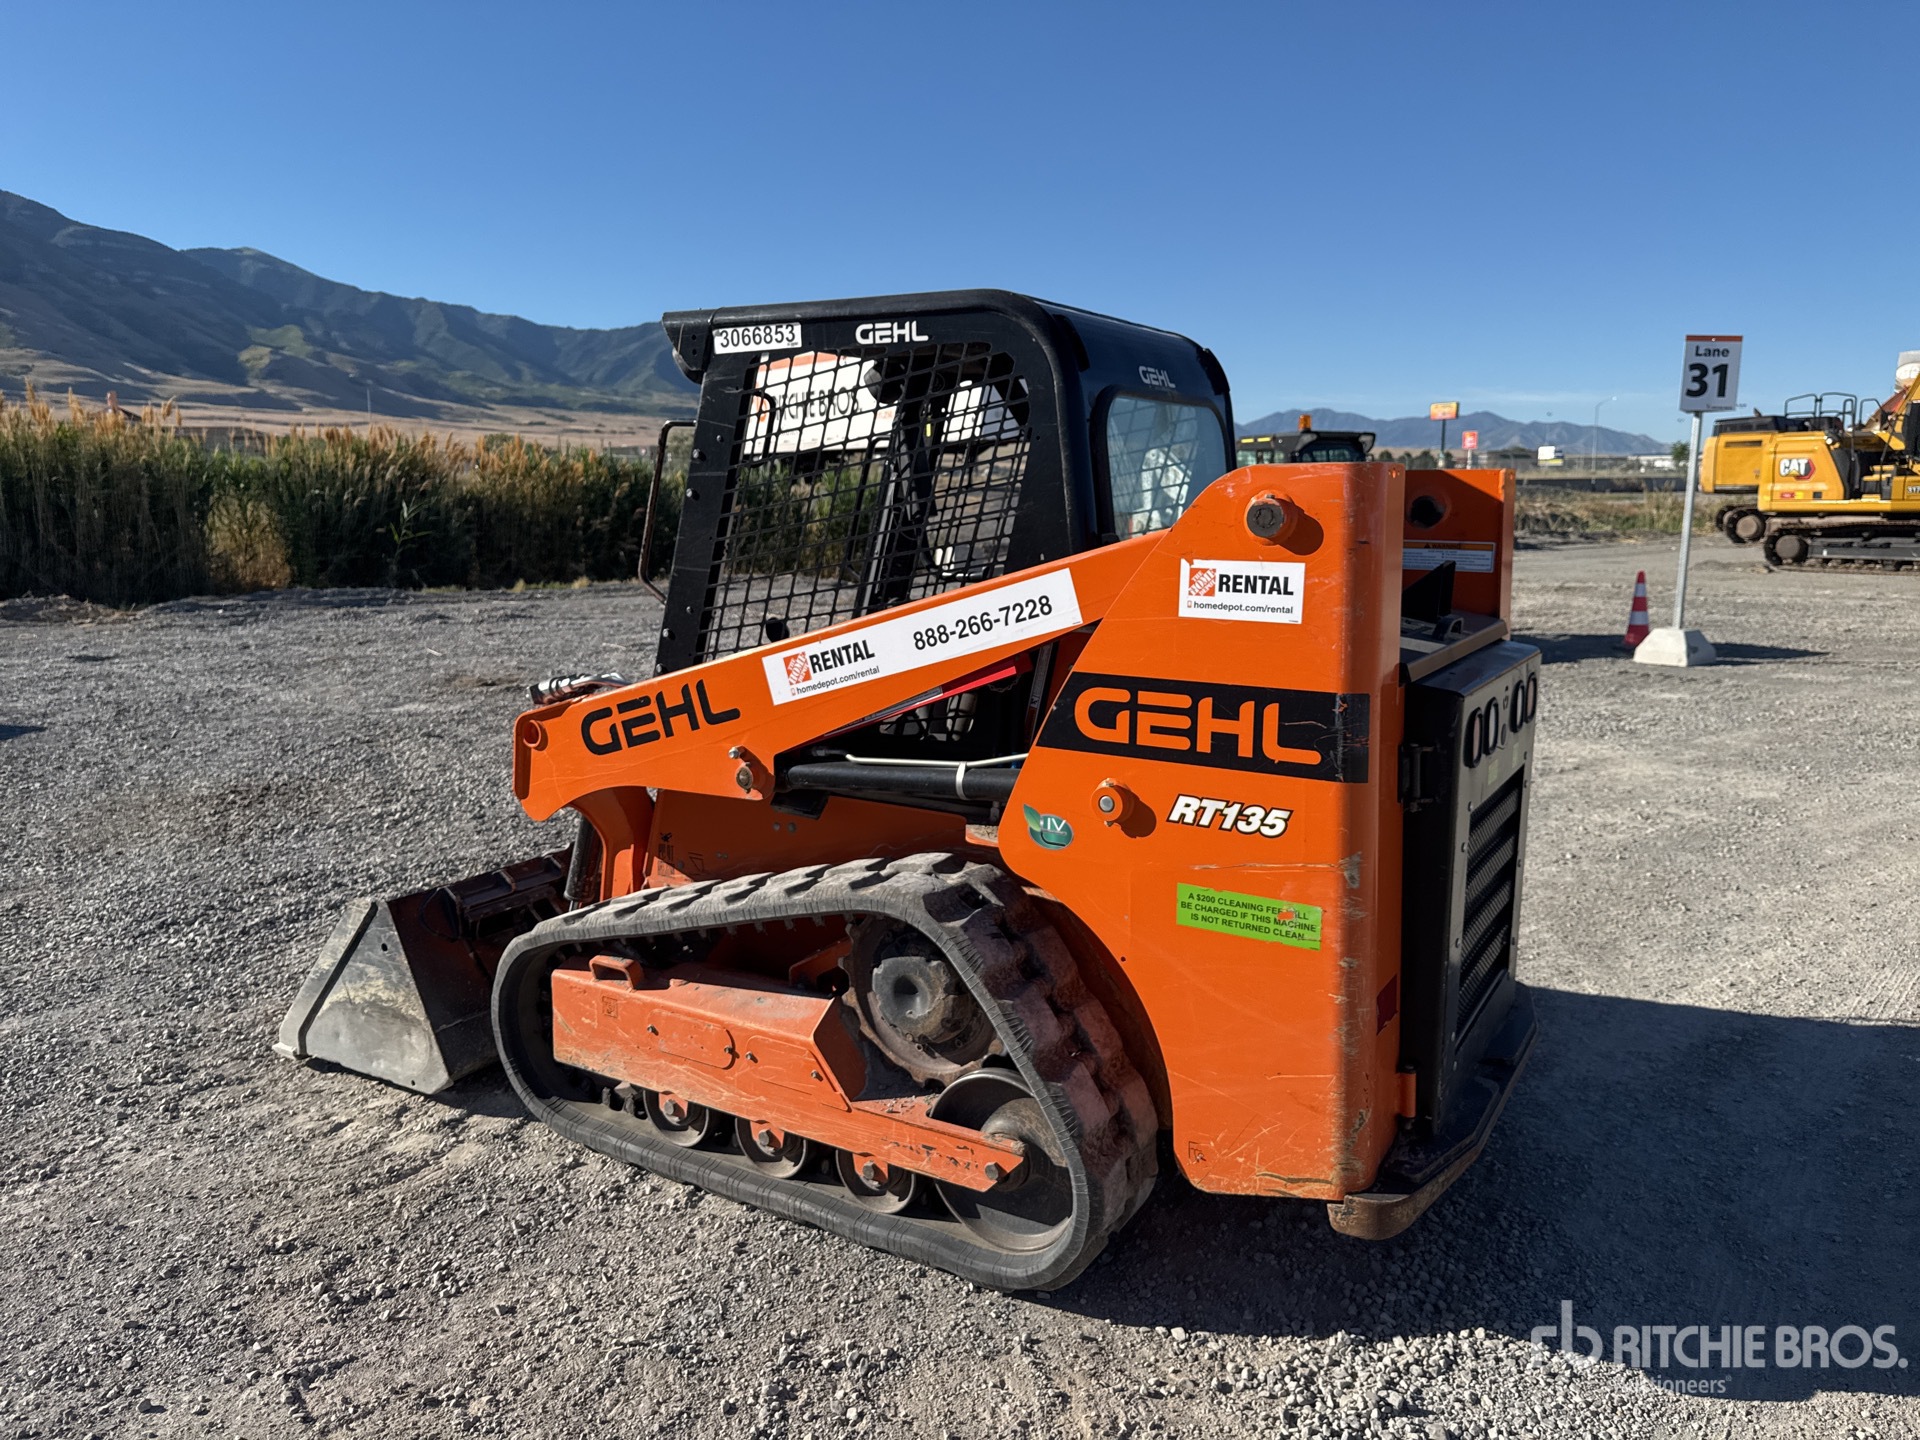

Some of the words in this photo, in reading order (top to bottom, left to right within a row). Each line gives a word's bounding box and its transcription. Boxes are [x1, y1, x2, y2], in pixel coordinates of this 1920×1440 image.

[720, 324, 796, 348] 3066853
[855, 320, 929, 344] GEHL
[1695, 345, 1730, 357] Lane
[1138, 365, 1176, 388] GEHL
[1685, 363, 1728, 398] 31
[1779, 458, 1809, 477] CAT
[1218, 574, 1294, 595] RENTAL
[1193, 601, 1293, 614] homedepot.com/rental
[913, 595, 1052, 650] 888-266-7228
[809, 640, 875, 674] RENTAL
[796, 666, 880, 695] homedepot.com/rental
[581, 679, 741, 755] GEHL
[1074, 687, 1322, 765] GEHL
[1167, 794, 1292, 838] RT135
[1188, 892, 1195, 900] A
[1196, 894, 1216, 904] $200
[1217, 897, 1264, 912] CLEANING
[1180, 901, 1193, 909] BE
[1194, 903, 1238, 918] CHARGED
[1250, 913, 1271, 924] THIS
[1273, 918, 1317, 932] MACHINE
[1190, 913, 1199, 921] IS
[1201, 915, 1219, 925] NOT
[1221, 918, 1271, 934] RETURNED
